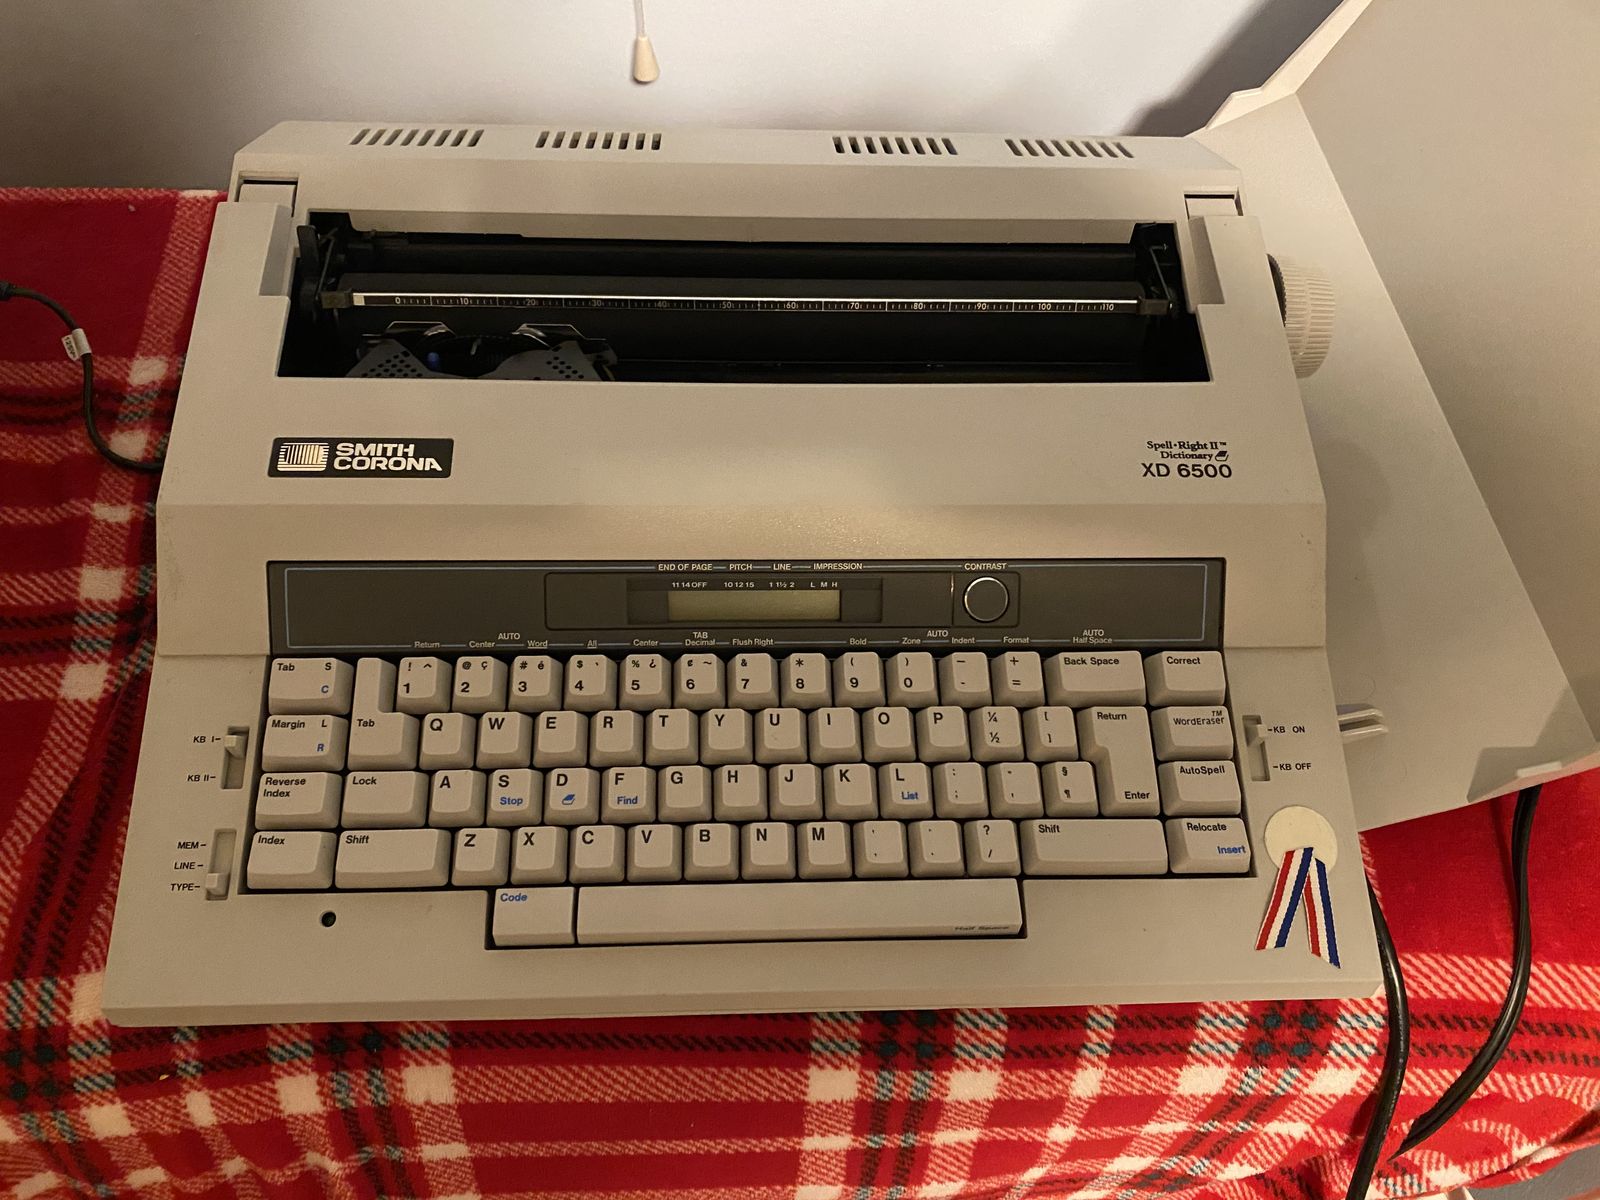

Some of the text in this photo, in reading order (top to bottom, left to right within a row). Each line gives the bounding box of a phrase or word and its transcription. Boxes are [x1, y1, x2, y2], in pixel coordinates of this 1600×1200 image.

[395, 297, 400, 305] 0
[460, 297, 468, 305] 10
[526, 299, 536, 307] 20
[657, 300, 667, 308] 40
[722, 301, 731, 309] 50
[787, 302, 796, 310] 60
[914, 302, 923, 310] 80
[977, 303, 986, 311] 90
[1039, 303, 1051, 311] 100
[1103, 303, 1114, 311] 110
[336, 443, 414, 456] SMITH
[1160, 451, 1213, 461] Dictionary
[334, 457, 442, 471] CORONA
[1141, 463, 1232, 478] XD 6500
[659, 563, 712, 572] END OF PAGE
[730, 563, 752, 571] PITCH
[774, 563, 791, 571] LINE
[814, 563, 862, 571] IMPRESSION
[964, 563, 1007, 571] CONTRAST
[498, 632, 520, 640] AUTO
[693, 632, 708, 640] TAB
[927, 630, 948, 638] AUTO
[1083, 629, 1104, 637] AUTO
[528, 640, 548, 649] Word
[588, 639, 597, 647] All
[633, 639, 658, 647] Center
[685, 639, 715, 647] Decimal
[733, 638, 773, 646] Flush Right
[850, 638, 867, 646] Bold
[902, 637, 920, 645] Zone
[952, 637, 975, 645] Indent
[1004, 636, 1029, 644] Format
[1073, 636, 1112, 645] Half Space
[415, 641, 440, 649] Return
[469, 641, 495, 649] Center
[577, 660, 583, 668] $
[632, 660, 640, 668] %
[741, 659, 747, 667] &
[1010, 657, 1019, 665] +
[1064, 657, 1119, 666] Back Space
[1167, 656, 1200, 664] Correct
[277, 663, 295, 671] Tab
[325, 662, 331, 670] S
[520, 661, 528, 669] #
[461, 682, 469, 692] 2
[518, 681, 527, 692] 3
[575, 680, 584, 691] 4
[631, 680, 640, 690] 5
[686, 679, 695, 689] 6
[741, 679, 749, 689] 7
[796, 678, 804, 689] 8
[850, 677, 858, 688] 9
[321, 685, 329, 693] C
[403, 683, 410, 693] 1
[1097, 712, 1127, 720] Return
[1212, 709, 1222, 717] TM
[603, 716, 613, 728] R
[659, 715, 668, 727] T
[715, 714, 725, 726] Y
[770, 714, 780, 726] U
[878, 712, 890, 724] O
[933, 712, 943, 724] P
[1173, 717, 1224, 725] WordEraser
[272, 720, 305, 730] Margin
[322, 720, 327, 728] L
[357, 719, 375, 727] Tab
[430, 718, 443, 731] Q
[488, 718, 505, 730] W
[546, 717, 556, 729] E
[1273, 726, 1305, 734] KB ON
[193, 736, 206, 744] KB
[317, 744, 324, 752] R
[1180, 765, 1225, 775] AutoSpell
[1280, 763, 1311, 771] KB OFF
[188, 774, 209, 782] KB II
[615, 773, 624, 785] F
[671, 771, 683, 784] G
[728, 770, 738, 783] H
[785, 769, 793, 782] J
[840, 769, 850, 782] K
[896, 768, 904, 781] L
[265, 777, 306, 785] Reverse
[353, 776, 376, 785] Lock
[440, 776, 450, 788] A
[499, 775, 509, 787] S
[557, 774, 568, 786] D
[264, 789, 290, 797] Index
[902, 792, 918, 800] List
[1125, 791, 1150, 799] Enter
[500, 797, 523, 806] Stop
[617, 796, 638, 804] Find
[983, 825, 990, 835] ?
[1039, 824, 1060, 833] Shift
[1187, 822, 1226, 831] Relocate
[582, 830, 594, 844] C
[641, 830, 652, 843] V
[700, 829, 710, 842] B
[757, 828, 767, 841] N
[812, 827, 824, 840] M
[258, 835, 285, 844] Index
[346, 835, 369, 844] Shift
[464, 834, 476, 847] Z
[523, 832, 534, 845] X
[178, 842, 199, 850] MEM
[1217, 845, 1246, 854] Insert
[174, 862, 195, 870] LINE
[171, 883, 194, 891] TYPE
[500, 893, 527, 902] Code
